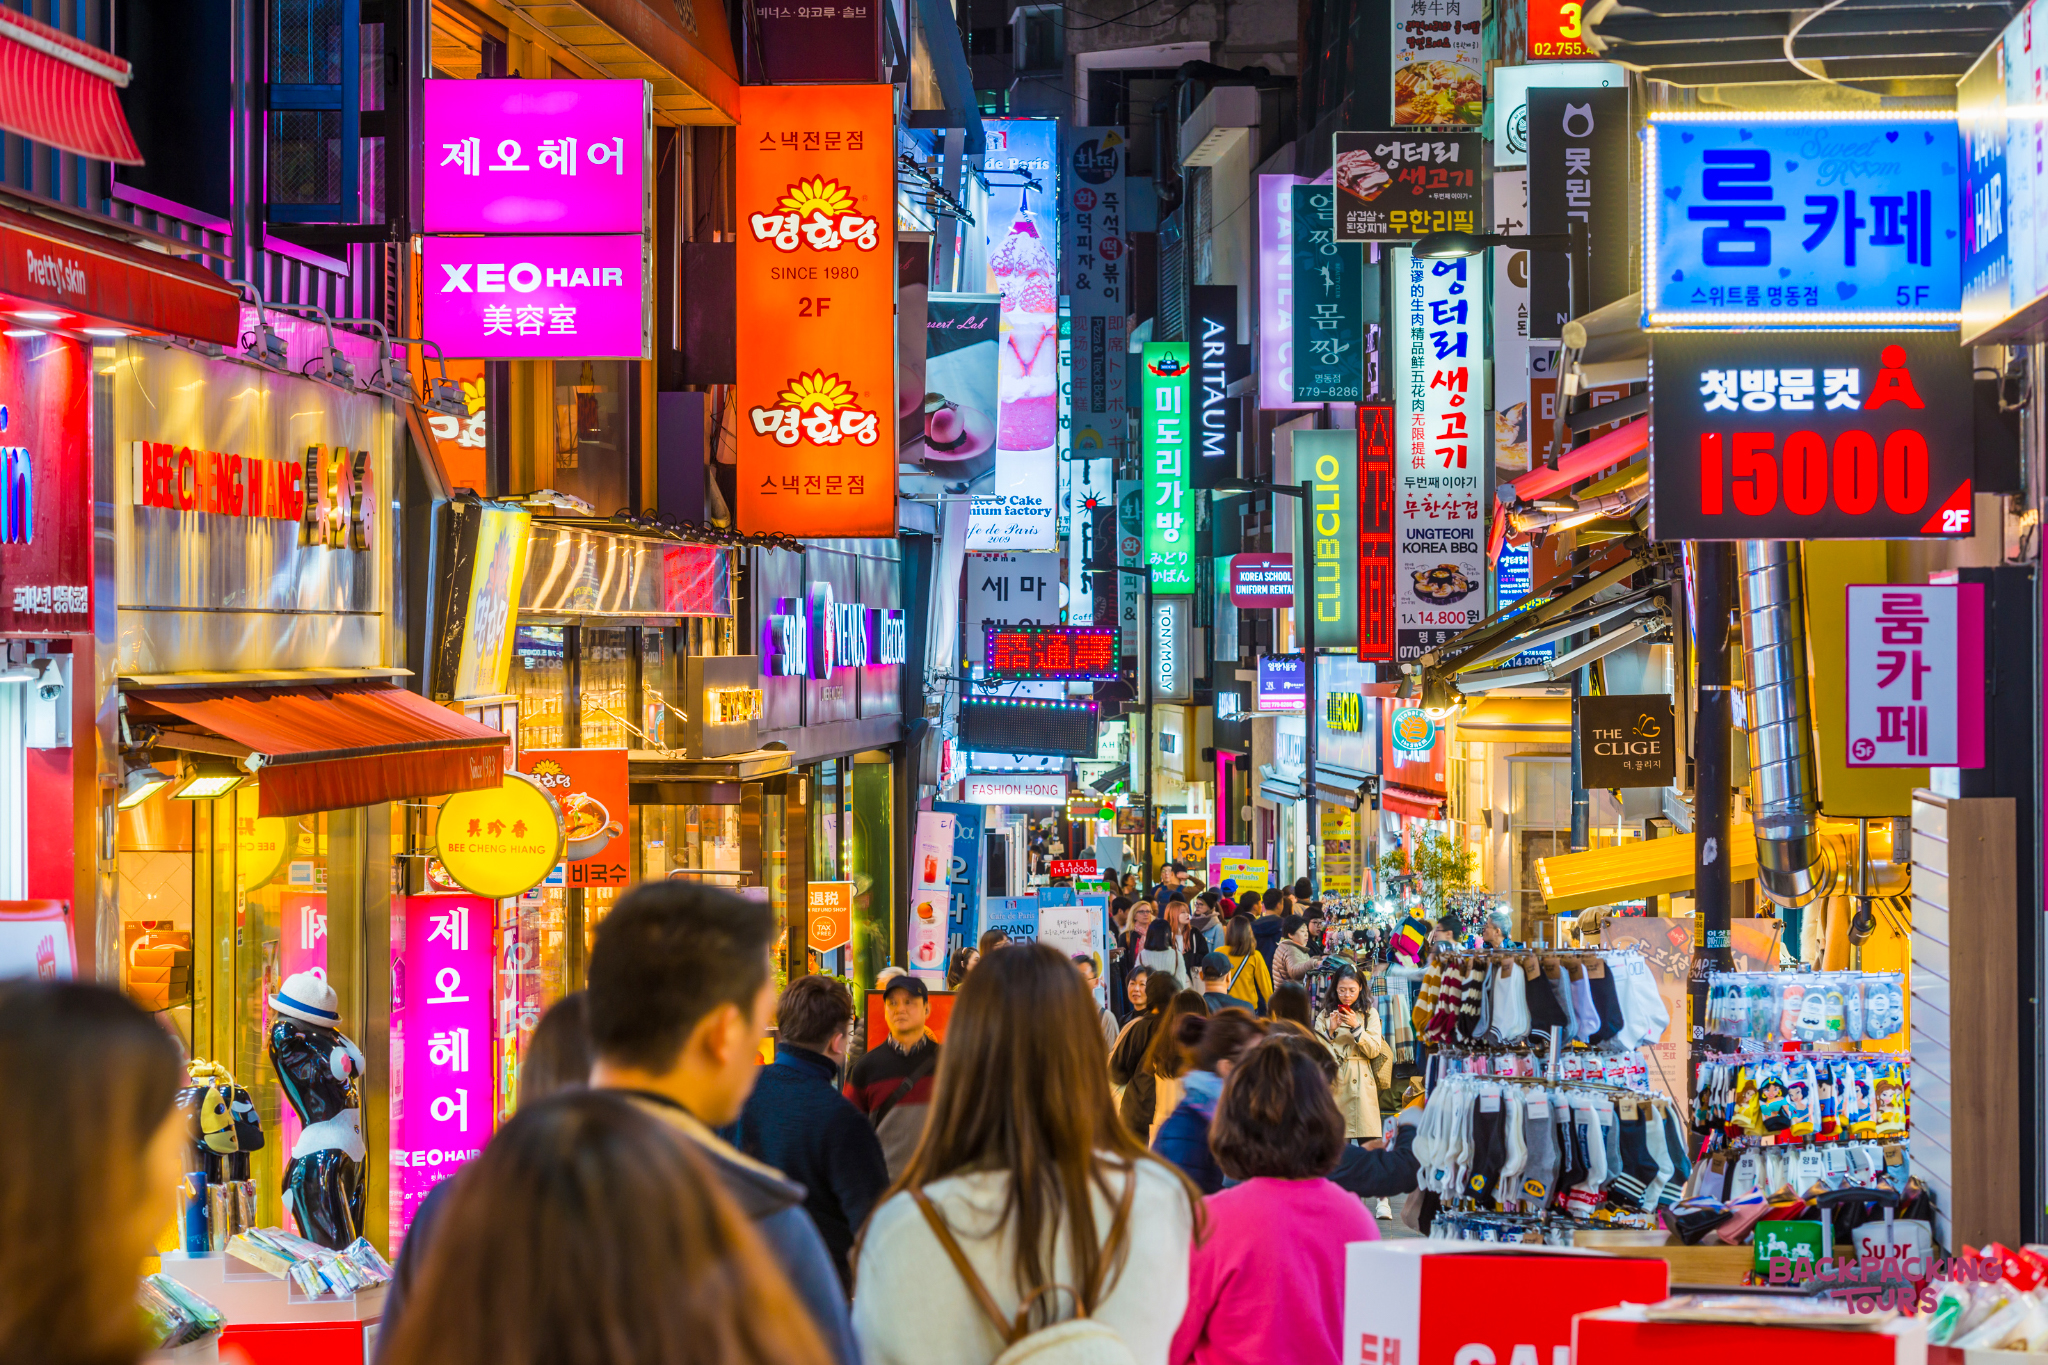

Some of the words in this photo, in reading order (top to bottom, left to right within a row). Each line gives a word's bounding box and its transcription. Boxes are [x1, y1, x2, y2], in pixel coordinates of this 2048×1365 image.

[440, 137, 624, 176] 제오헤어
[1375, 141, 1460, 170] 엉터리
[1398, 166, 1474, 195] 생고기
[749, 210, 879, 252] 명화당
[771, 267, 817, 280] SINCE
[823, 267, 859, 280] 1980
[1691, 286, 1761, 307] 스위트룸
[1767, 286, 1818, 307] 명동점
[1896, 286, 1930, 306] 5F
[798, 297, 831, 317] 2F
[483, 304, 578, 336] 美容室
[1202, 317, 1226, 457] ARITAUM
[1298, 386, 1359, 397] 779-8286
[750, 407, 879, 446] 명화당
[1430, 367, 1469, 470] 생고기
[1155, 385, 1185, 543] 미도리가방
[1700, 429, 1930, 516] 15000
[142, 441, 174, 508] BEE
[178, 446, 244, 517] CHENG
[248, 457, 304, 522] HIANG
[1404, 477, 1440, 489] 두번째
[1442, 476, 1477, 489] 이야기
[1009, 495, 1042, 505] Cake
[1004, 505, 1052, 518] factory
[1942, 510, 1970, 532] 2F
[1406, 528, 1474, 540] UNGTEORI
[1150, 551, 1188, 565] みどり
[1402, 542, 1448, 554] KOREA
[1450, 542, 1478, 554] BBQ
[1152, 569, 1190, 583] かばん
[1240, 571, 1264, 582] KOREA
[1264, 571, 1292, 582] SCHOOL
[981, 576, 1047, 601] 세마
[1236, 584, 1269, 595] UNIFORM
[834, 602, 868, 668] VENUS
[1160, 606, 1173, 692] TONYMOLY
[1875, 593, 1932, 757] 룸카페
[1592, 728, 1622, 740] THE
[1593, 741, 1661, 756] CLIGE
[1854, 741, 1873, 758] 5F
[972, 784, 1021, 796] FASHION
[1025, 784, 1058, 797] HONG
[448, 843, 465, 853] BEE
[468, 843, 507, 854] CHENG
[510, 845, 546, 855] HIANG
[810, 891, 839, 906] 退税
[427, 907, 469, 1132] 제오헤어
